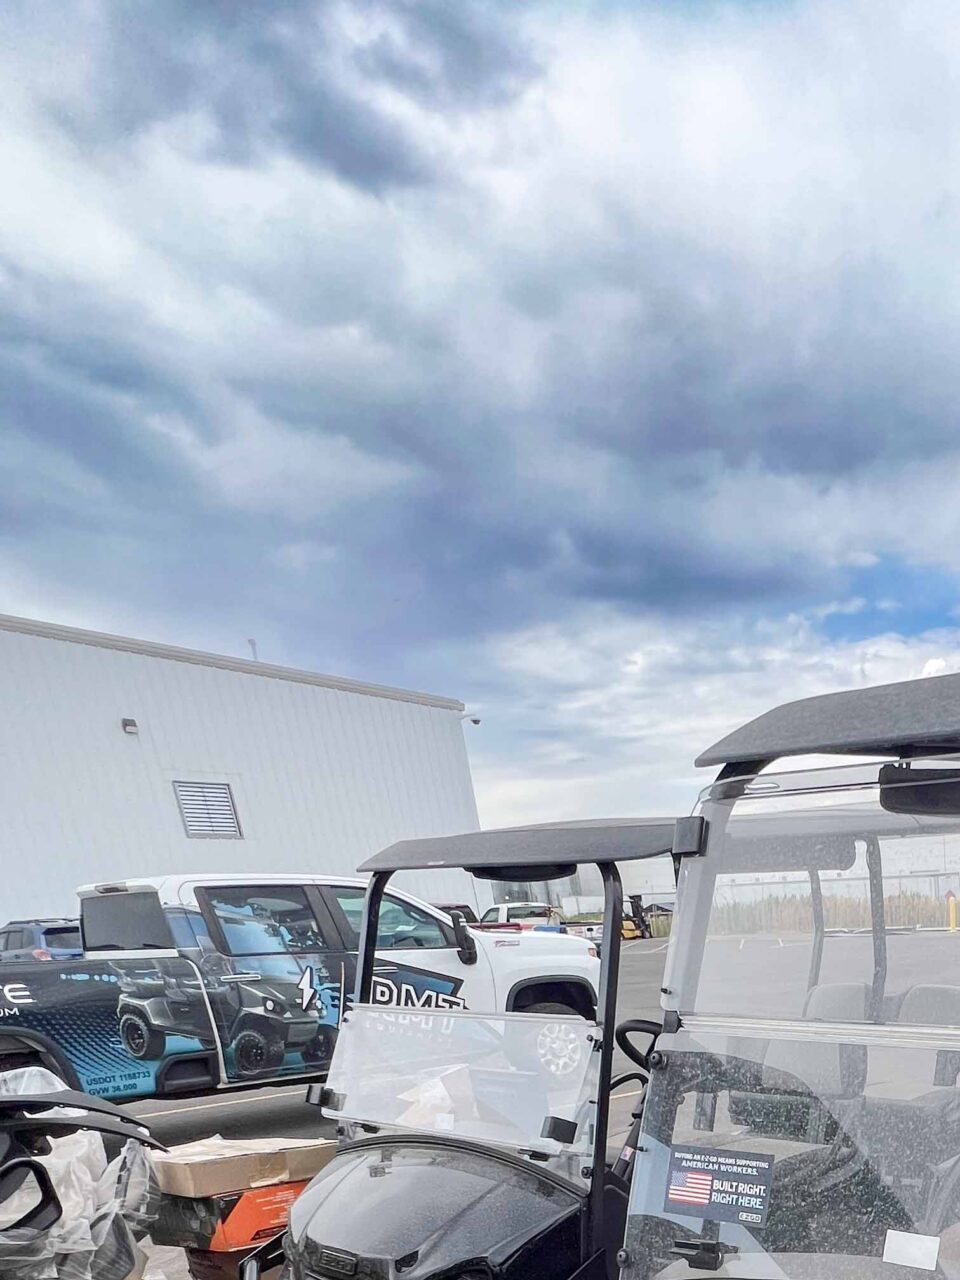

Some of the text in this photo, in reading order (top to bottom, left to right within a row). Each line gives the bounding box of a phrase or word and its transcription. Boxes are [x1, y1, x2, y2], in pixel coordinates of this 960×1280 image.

[0, 983, 37, 1004] E
[86, 1075, 116, 1086] USDOT
[88, 1086, 109, 1096] GVW
[681, 1160, 759, 1176] AMERICAN WORKERS.
[718, 1157, 736, 1165] MEANS
[736, 1158, 769, 1169] SUPPORTING
[712, 1180, 766, 1196] BUILT RIGHT.
[711, 1192, 764, 1209] RIGHT HERE.
